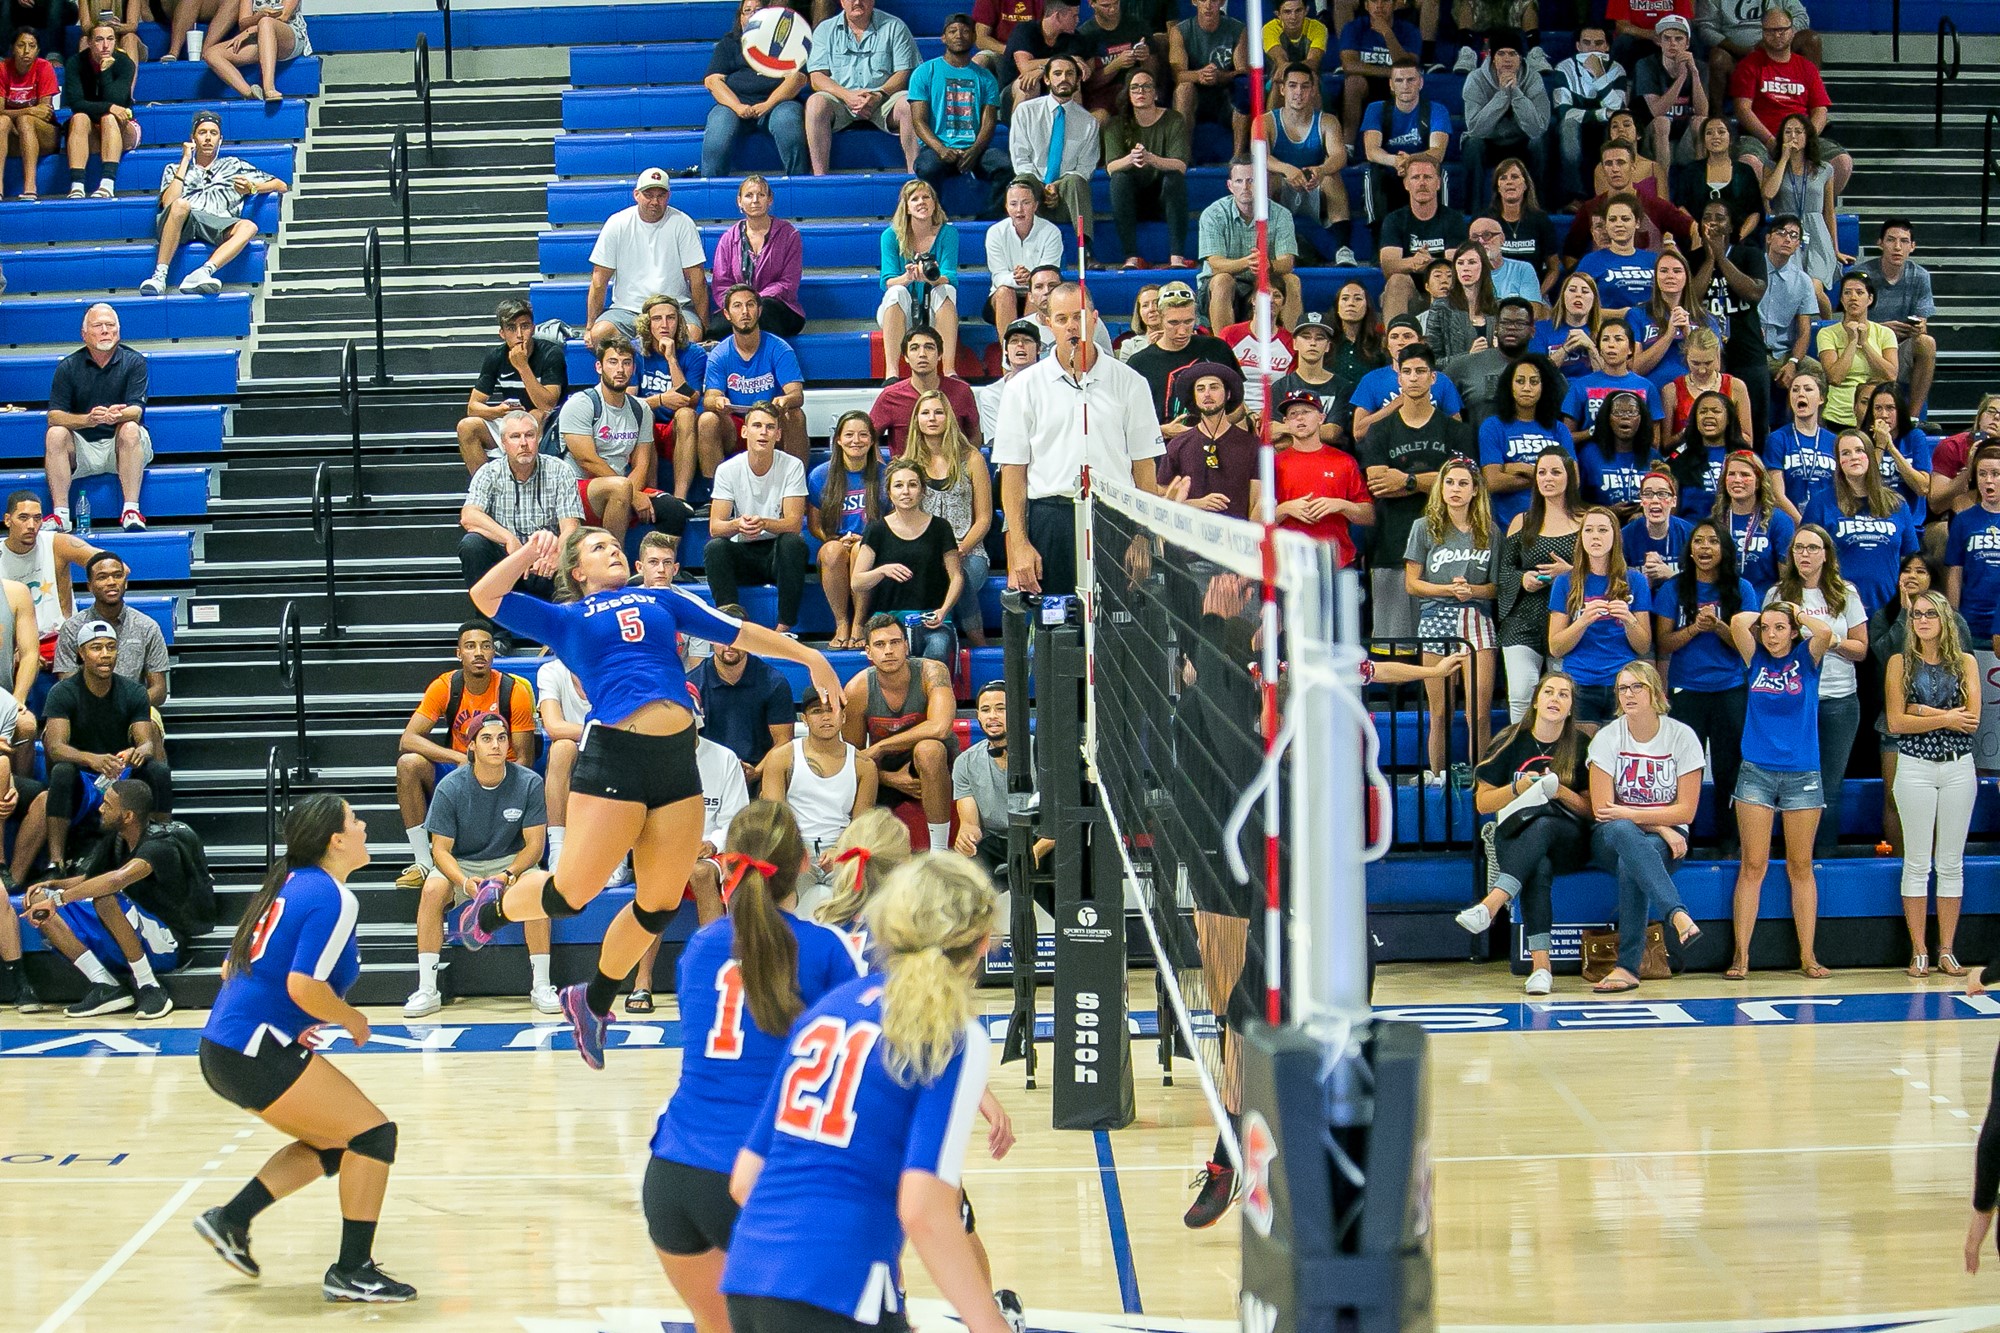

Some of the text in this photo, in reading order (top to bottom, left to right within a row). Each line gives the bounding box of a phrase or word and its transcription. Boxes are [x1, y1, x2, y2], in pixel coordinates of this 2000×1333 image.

[1360, 51, 1392, 66] JESSU
[1760, 81, 1804, 95] JESSUP
[1605, 269, 1654, 281] JESSU
[1238, 346, 1291, 370] Jeup
[641, 375, 672, 393] JESSU
[1389, 440, 1447, 458] OAKLEY CA
[1836, 520, 1896, 538] JESSUP
[1431, 548, 1491, 573] Jessup
[615, 606, 645, 642] 5
[1617, 756, 1678, 788] WJU
[1063, 928, 1087, 936] SPORTS
[988, 962, 1013, 970] AVAILA
[706, 958, 746, 1060] 1
[775, 1014, 883, 1149] 21
